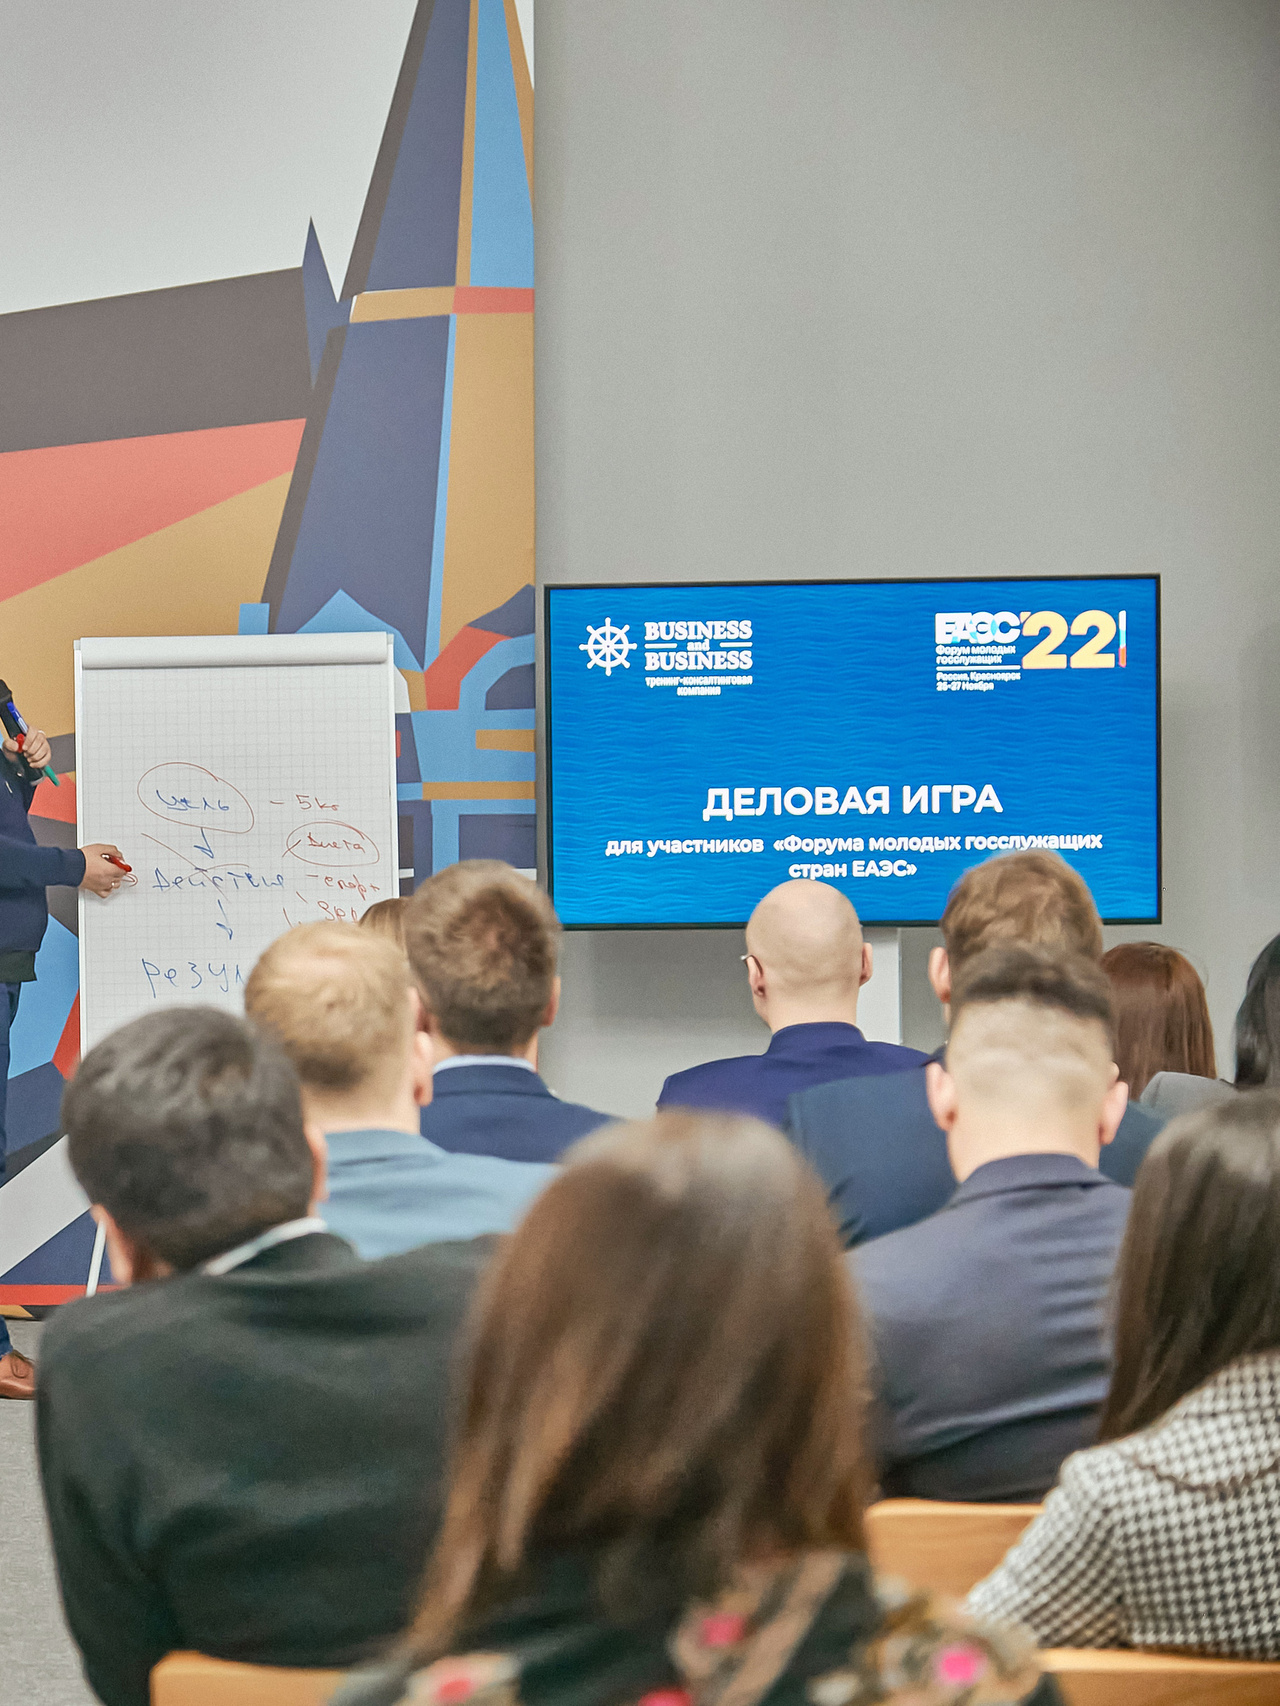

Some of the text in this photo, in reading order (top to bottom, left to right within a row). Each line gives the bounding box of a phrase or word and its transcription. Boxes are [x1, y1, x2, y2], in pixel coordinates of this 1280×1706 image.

[644, 620, 753, 641] BUSINESS
[686, 638, 710, 651] and
[935, 645, 1016, 656] Форум молодых
[644, 650, 753, 671] BUSINESS
[936, 655, 1002, 666] госслужащих
[645, 675, 753, 688] тренинг-консалтинговая
[936, 672, 1021, 682] Россия, Красноярск
[677, 686, 721, 696] компания
[962, 682, 994, 692] Ноября
[702, 784, 1004, 822] ДЕЛОВАЯ ИГРА
[605, 834, 1103, 858] для участников «Форума молодых госслужащих
[788, 860, 918, 880] стран ЕАЭС»
